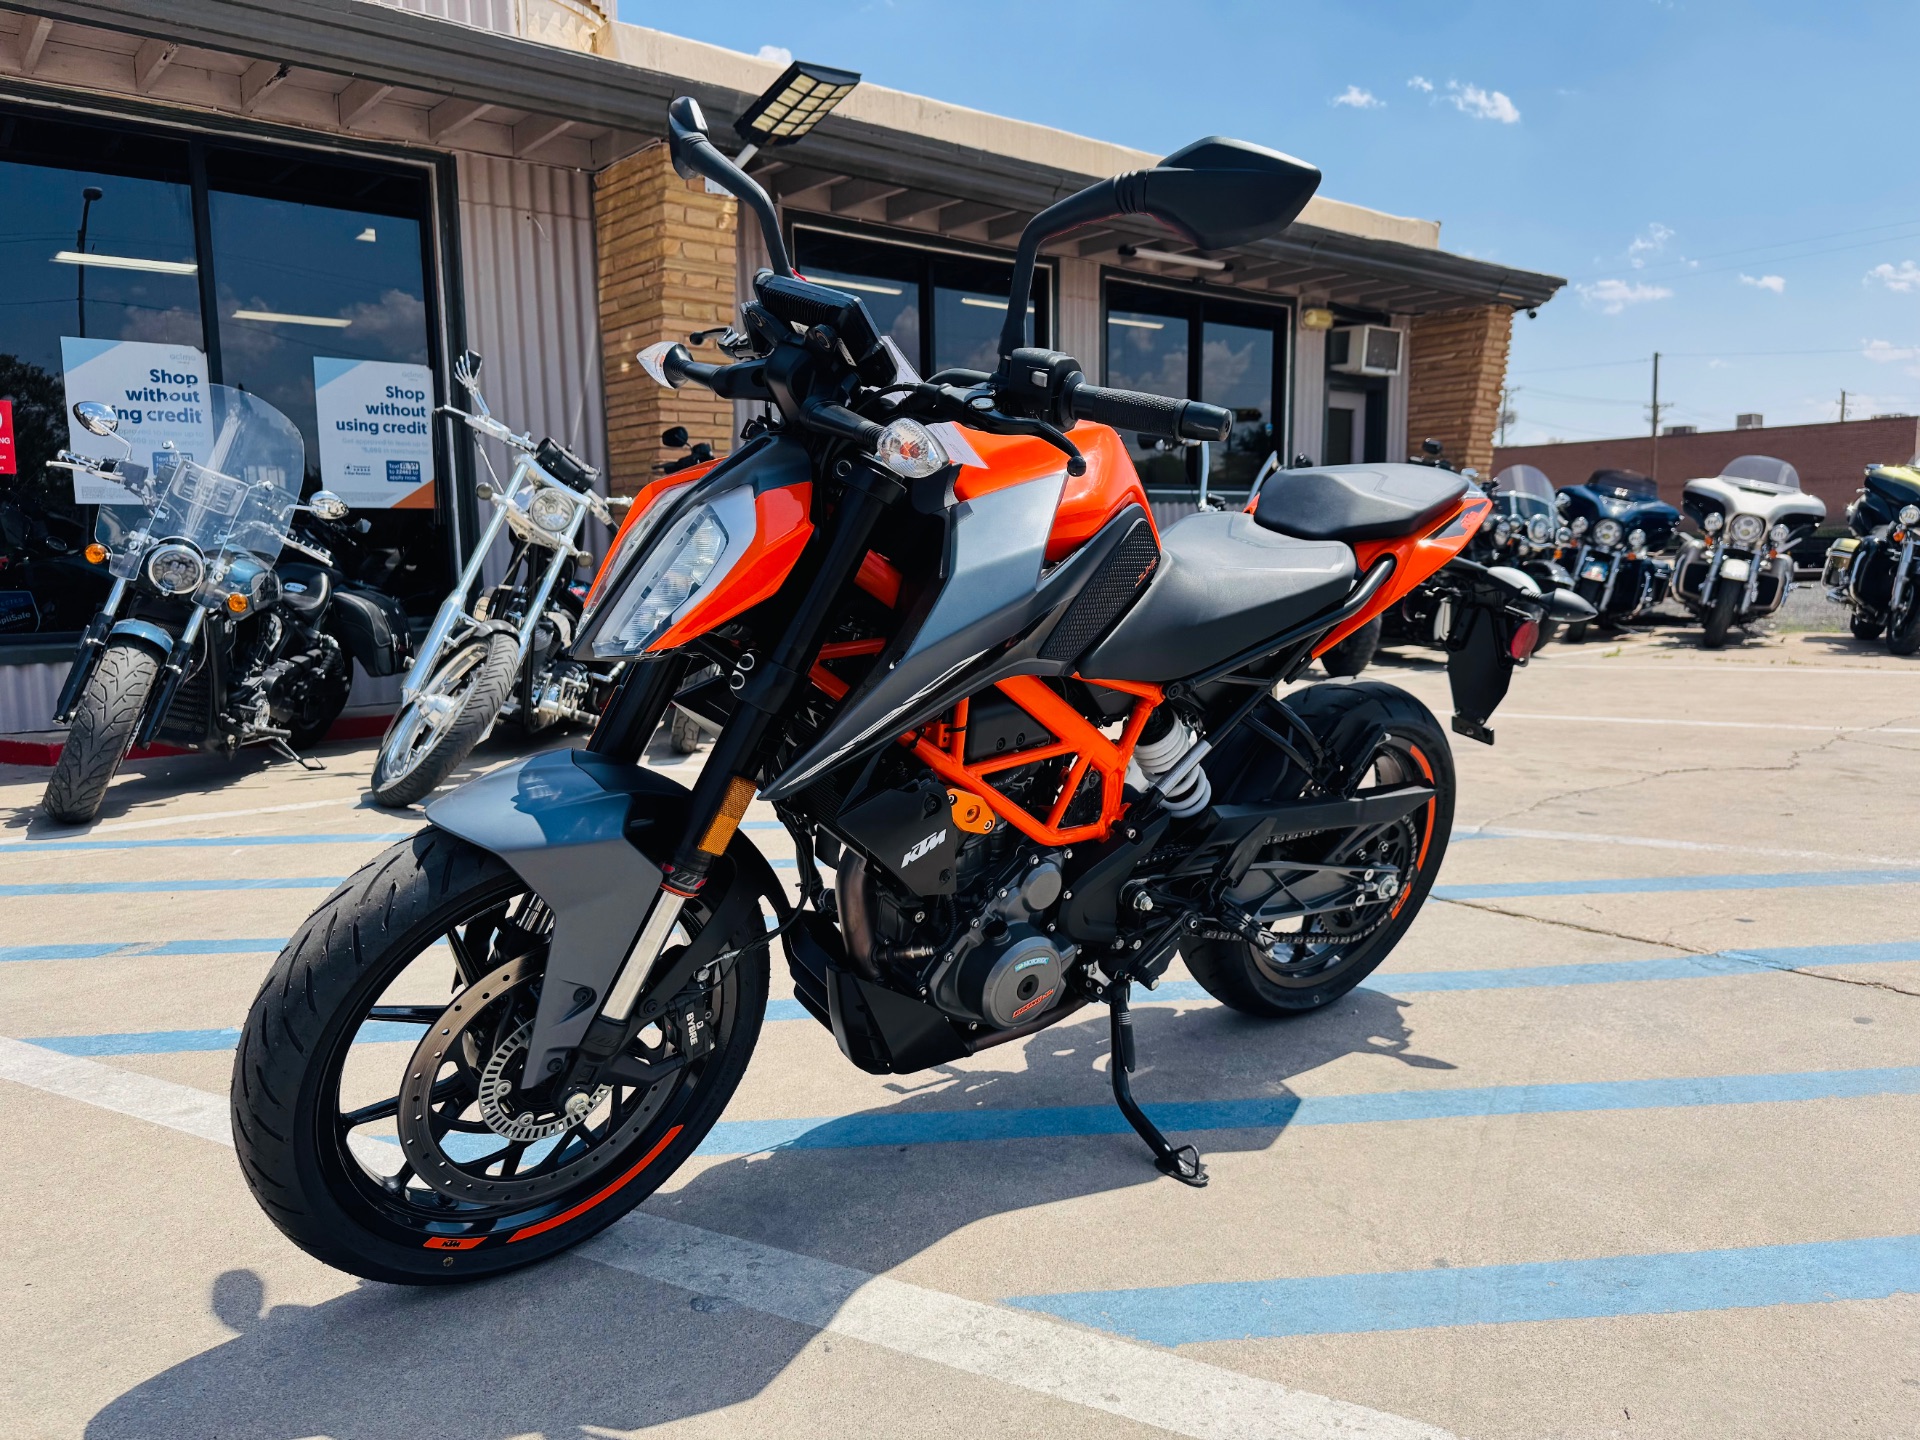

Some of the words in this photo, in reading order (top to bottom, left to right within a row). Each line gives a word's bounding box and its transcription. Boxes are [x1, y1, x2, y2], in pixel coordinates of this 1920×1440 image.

[149, 368, 198, 388] Shop
[125, 386, 200, 403] without
[385, 385, 425, 403] Shop
[111, 404, 142, 424] ing
[365, 402, 426, 418] without
[335, 418, 379, 435] using
[900, 828, 947, 869] KTM
[686, 1011, 699, 1046] BYBRE
[441, 1239, 461, 1248] KTM
